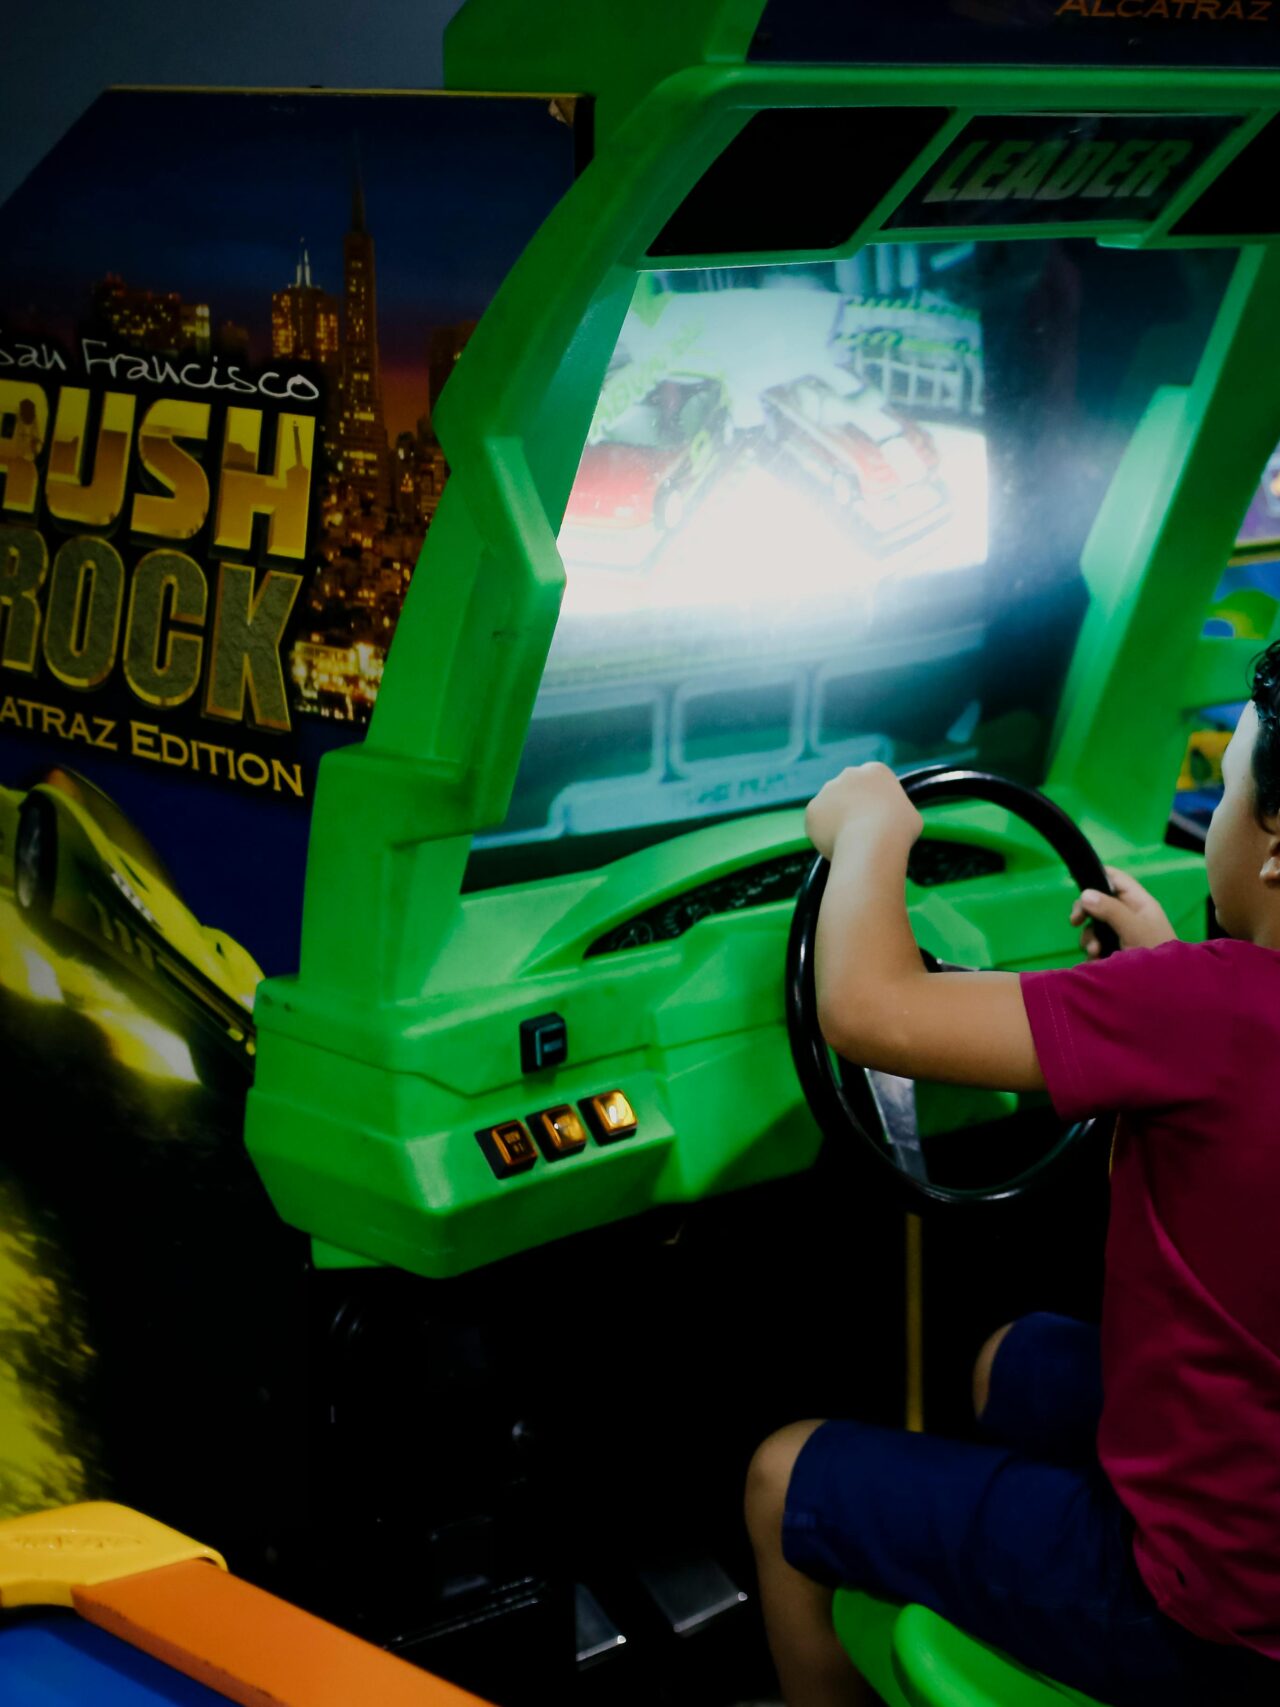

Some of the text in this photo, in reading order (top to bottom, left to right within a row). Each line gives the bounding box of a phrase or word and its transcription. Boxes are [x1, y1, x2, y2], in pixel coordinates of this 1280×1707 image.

[1054, 0, 1271, 22] ALCATRAZ
[922, 138, 1194, 203] LEADER
[82, 337, 320, 401] Francisco
[129, 719, 306, 799] EDITION
